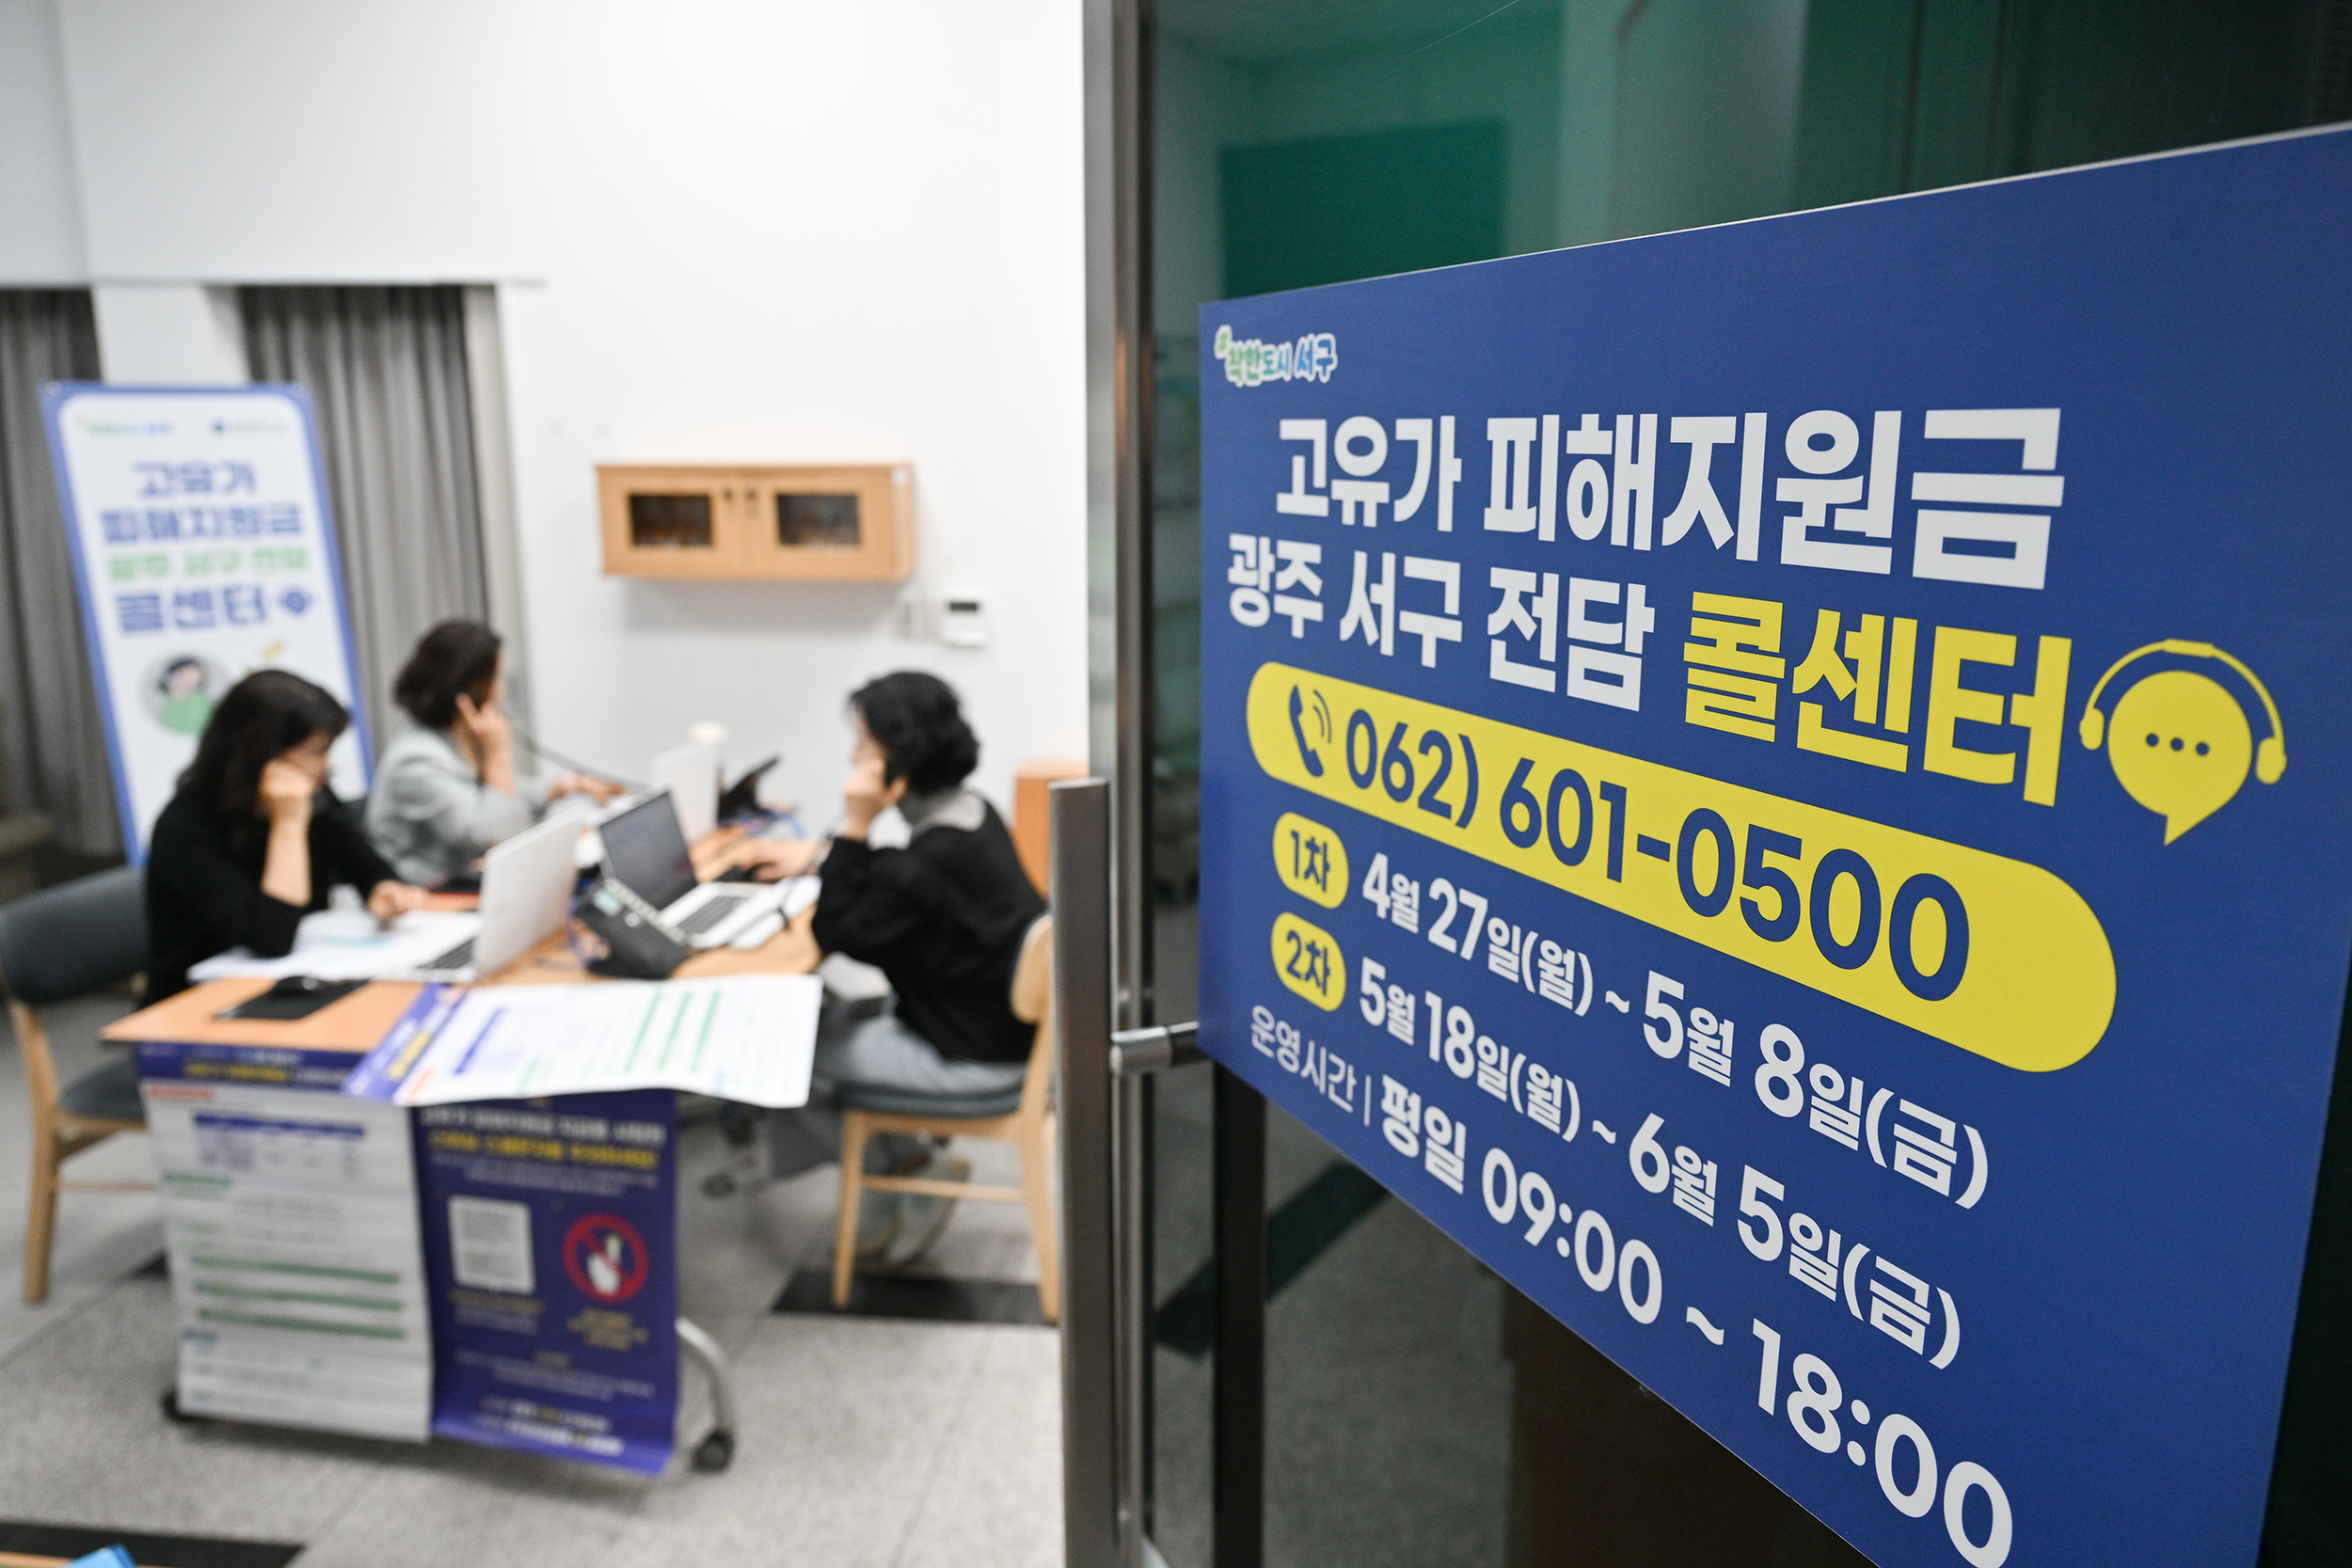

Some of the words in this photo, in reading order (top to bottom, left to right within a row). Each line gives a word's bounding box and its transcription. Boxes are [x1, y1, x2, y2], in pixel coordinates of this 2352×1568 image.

[1224, 339, 1293, 388] 착한도시
[1294, 333, 1338, 384] 서구
[1276, 415, 1463, 532] 고유가
[1483, 407, 2066, 590] 피해지원금
[1227, 532, 1324, 640] 광주
[1339, 550, 1463, 669] 서구
[1486, 566, 1656, 712] 전담
[1683, 591, 2073, 807] 콜센터
[1346, 708, 1479, 830] 062)
[1499, 756, 1971, 1002] 601-0500
[1285, 928, 1331, 997] 2차
[1359, 957, 1416, 1046] 5월
[1423, 990, 1581, 1143] 18일(월)
[1629, 1112, 1718, 1227] 6월
[1737, 1164, 1961, 1370] 5일(금)
[1290, 829, 1331, 893] 1차
[1362, 852, 1419, 934] 4월
[1427, 878, 1594, 1017] 27일(월)
[1643, 970, 1735, 1087] 5월
[1755, 1023, 1989, 1210] 8일(금)
[1250, 1005, 1358, 1114] 운영시간
[1380, 1073, 1467, 1195] 평일
[1482, 1147, 1662, 1324] 09:00
[1752, 1318, 2013, 1568] 18:00
